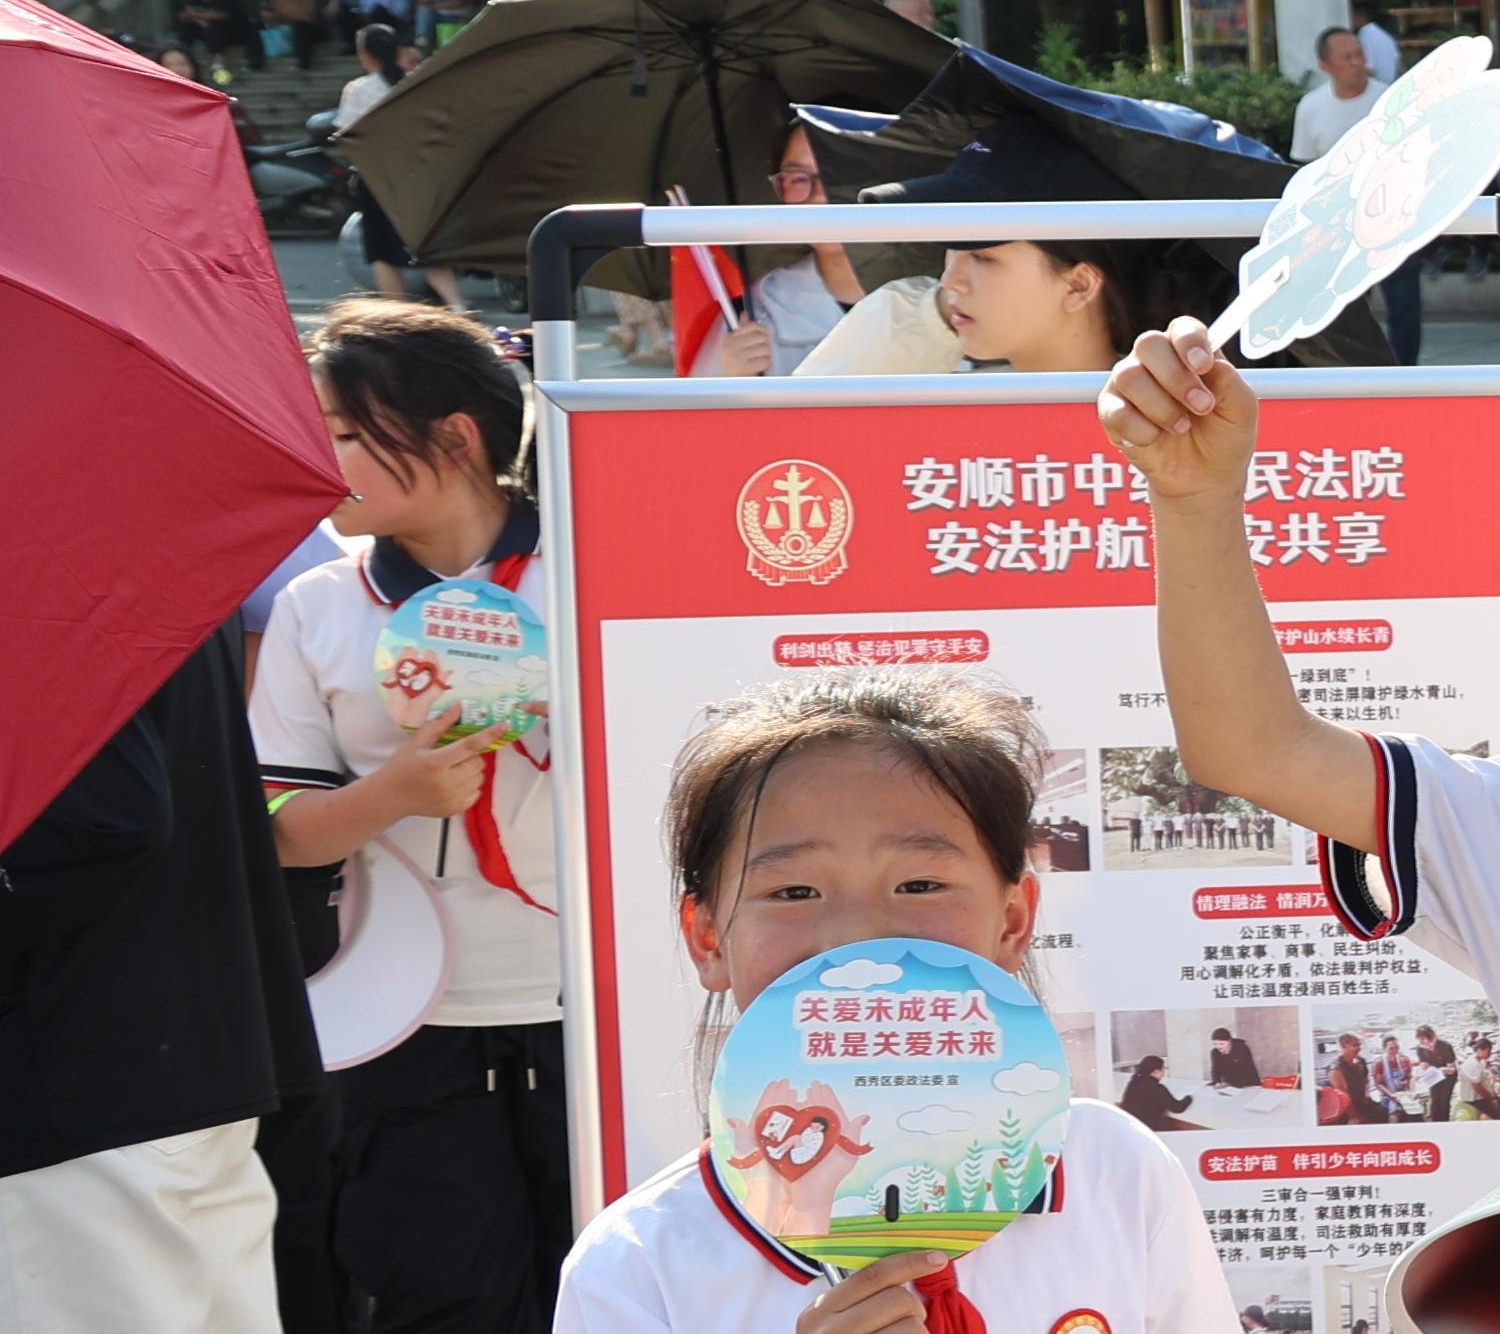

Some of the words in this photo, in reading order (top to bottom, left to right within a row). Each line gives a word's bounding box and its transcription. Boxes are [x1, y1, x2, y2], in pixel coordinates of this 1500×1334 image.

[902, 445, 1406, 512] 安顺市中民法院
[1196, 892, 1268, 912] 情理融法
[799, 995, 990, 1024] 关爱未成年人
[806, 1029, 999, 1058] 就是关爱未来
[1207, 1154, 1278, 1174] 安法护苗
[1292, 1148, 1433, 1170] 伴引少年向阳成长
